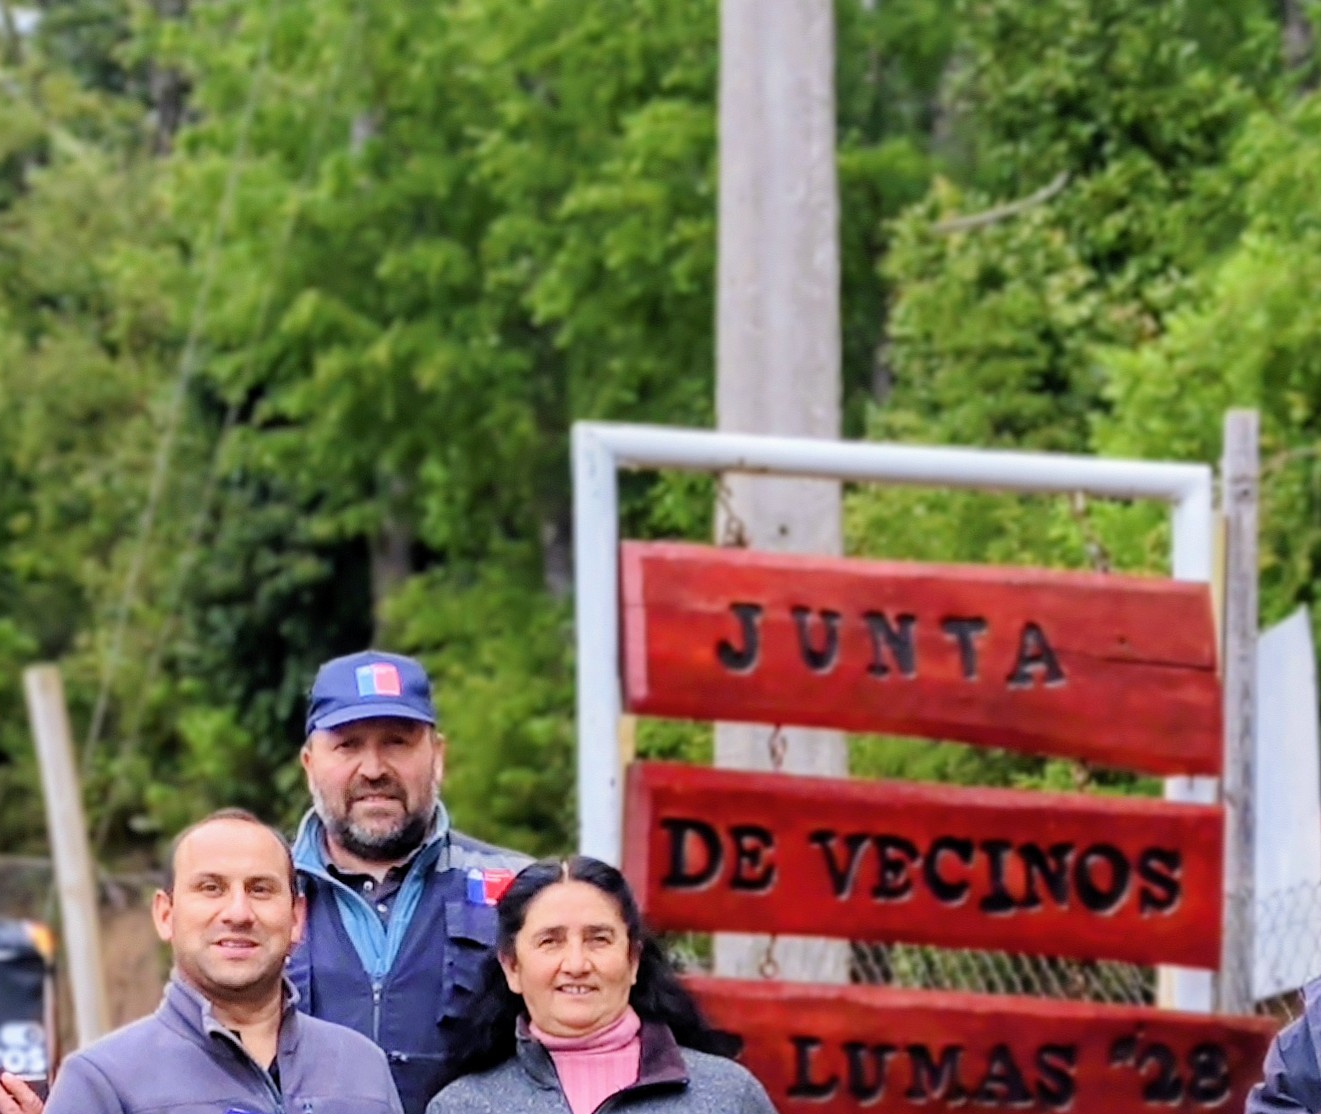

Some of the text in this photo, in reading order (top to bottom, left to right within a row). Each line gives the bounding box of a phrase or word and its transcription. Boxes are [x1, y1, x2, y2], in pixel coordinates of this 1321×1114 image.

[716, 602, 1066, 689] JUNTA
[660, 817, 1181, 917] DE VECINOS
[787, 1034, 1077, 1114] LUMAS
